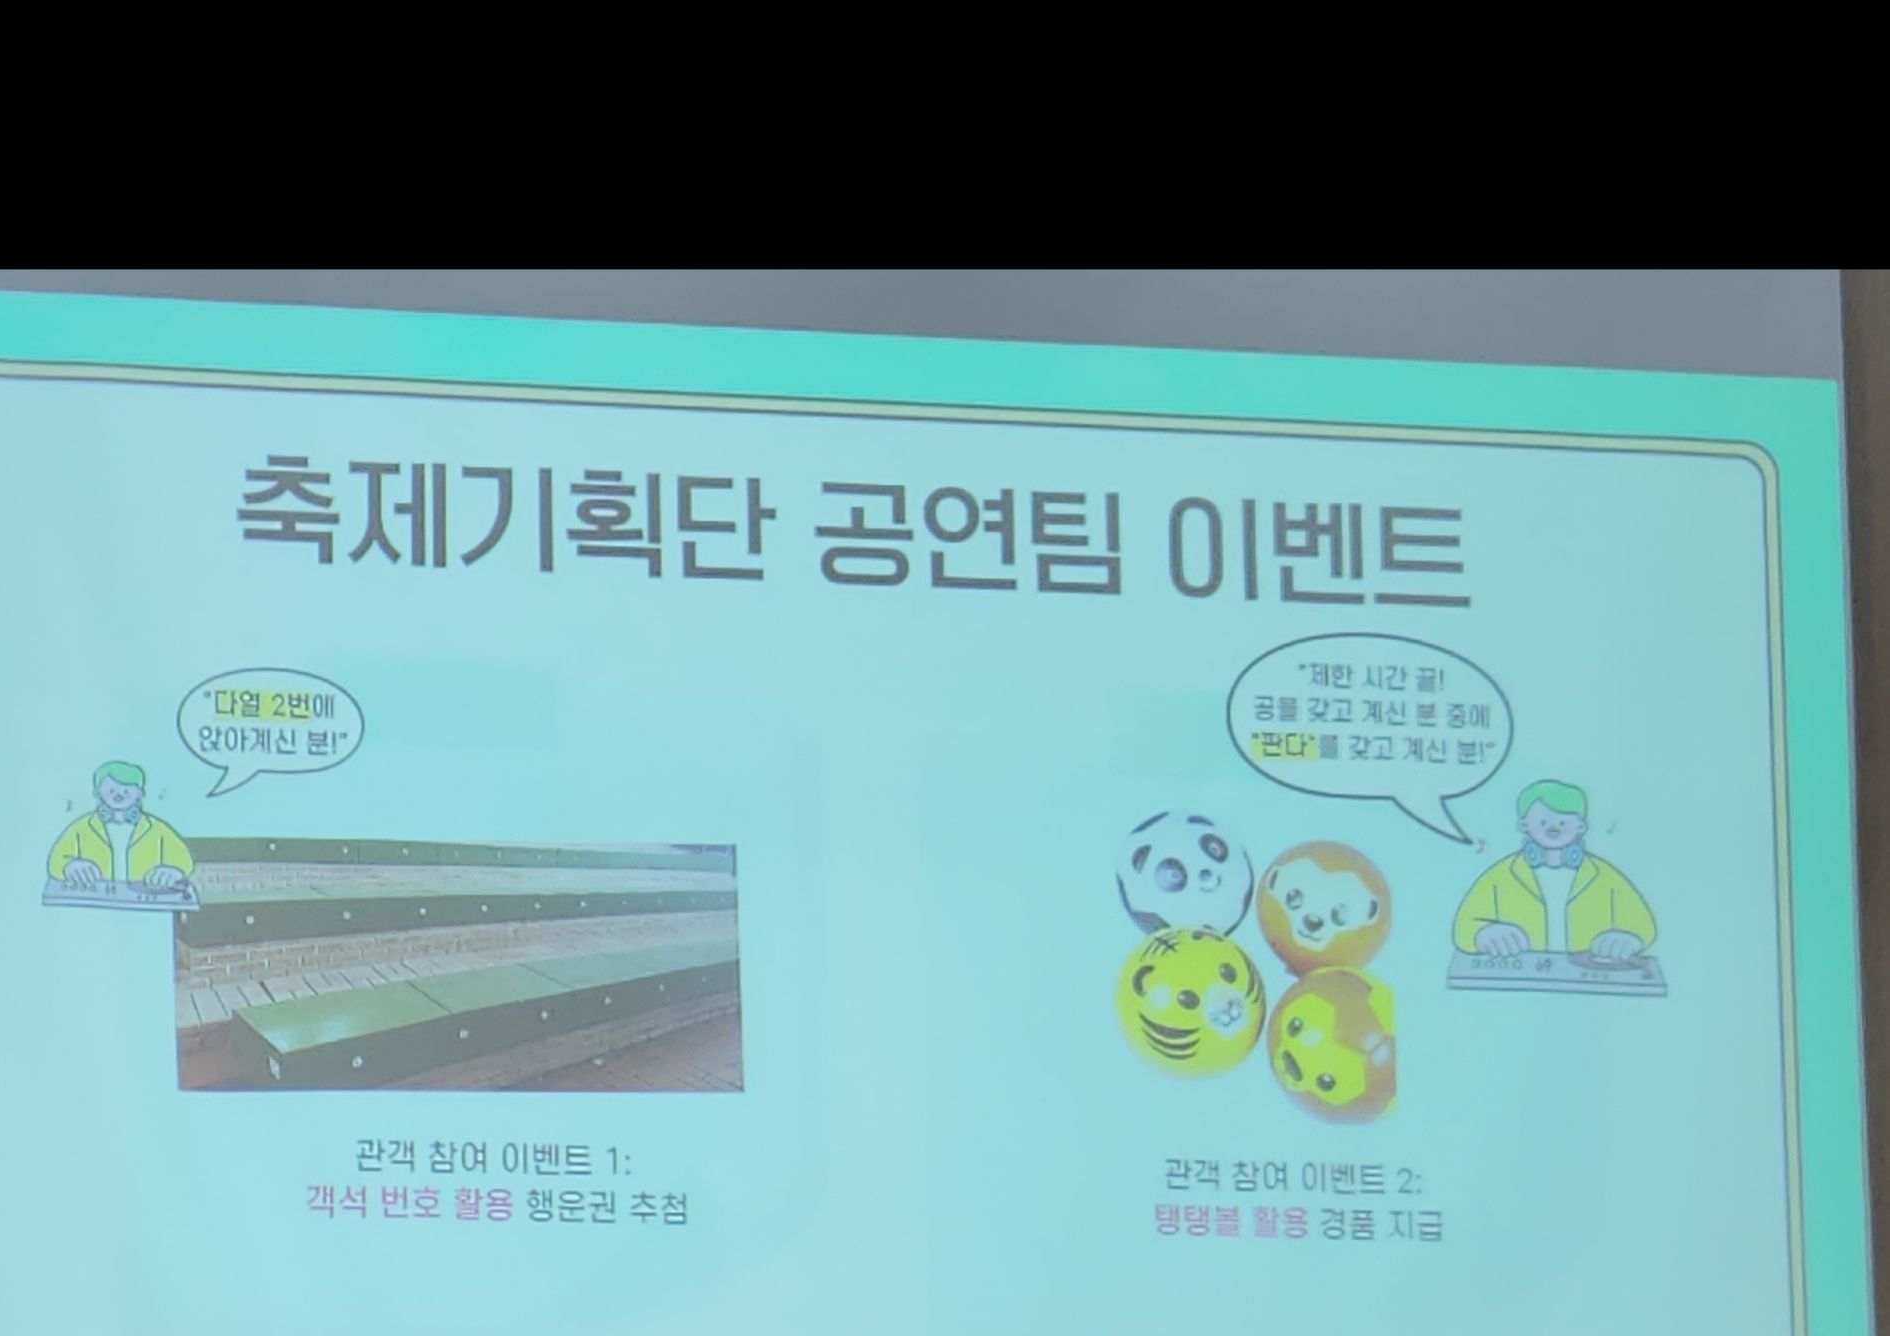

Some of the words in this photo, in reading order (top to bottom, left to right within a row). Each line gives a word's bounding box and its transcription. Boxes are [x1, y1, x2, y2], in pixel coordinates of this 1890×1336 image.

[233, 451, 777, 584] 축제기획단
[812, 478, 1127, 598] 공연팀
[1163, 494, 1473, 609] 이벤트
[1363, 665, 1408, 692] 시간
[270, 692, 336, 720] 2번에
[1307, 697, 1354, 724] 갖고
[1362, 699, 1407, 727] 계신
[1415, 702, 1438, 728] 분
[1446, 703, 1491, 729] 중에
[198, 725, 298, 756] 앉아계신
[1348, 735, 1395, 762] 갖고
[1402, 737, 1447, 764] 계신
[355, 1138, 416, 1174] 관객
[427, 1139, 489, 1175] 참여
[501, 1141, 593, 1177] 이벤트
[604, 1145, 633, 1176] 1:
[1164, 1157, 1220, 1191] 관객
[1231, 1160, 1288, 1193] 참여
[1300, 1161, 1386, 1196] 이벤트
[1395, 1166, 1424, 1196] 2:
[305, 1184, 368, 1219] 객석
[379, 1185, 442, 1220] 번호
[452, 1186, 515, 1223] 활용
[526, 1188, 617, 1225] 행운권
[628, 1190, 689, 1226] 추첨
[1153, 1203, 1240, 1238] 탱탱볼
[1253, 1205, 1309, 1240] 활용
[1320, 1208, 1375, 1242] 경품
[1388, 1209, 1443, 1243] 지급
